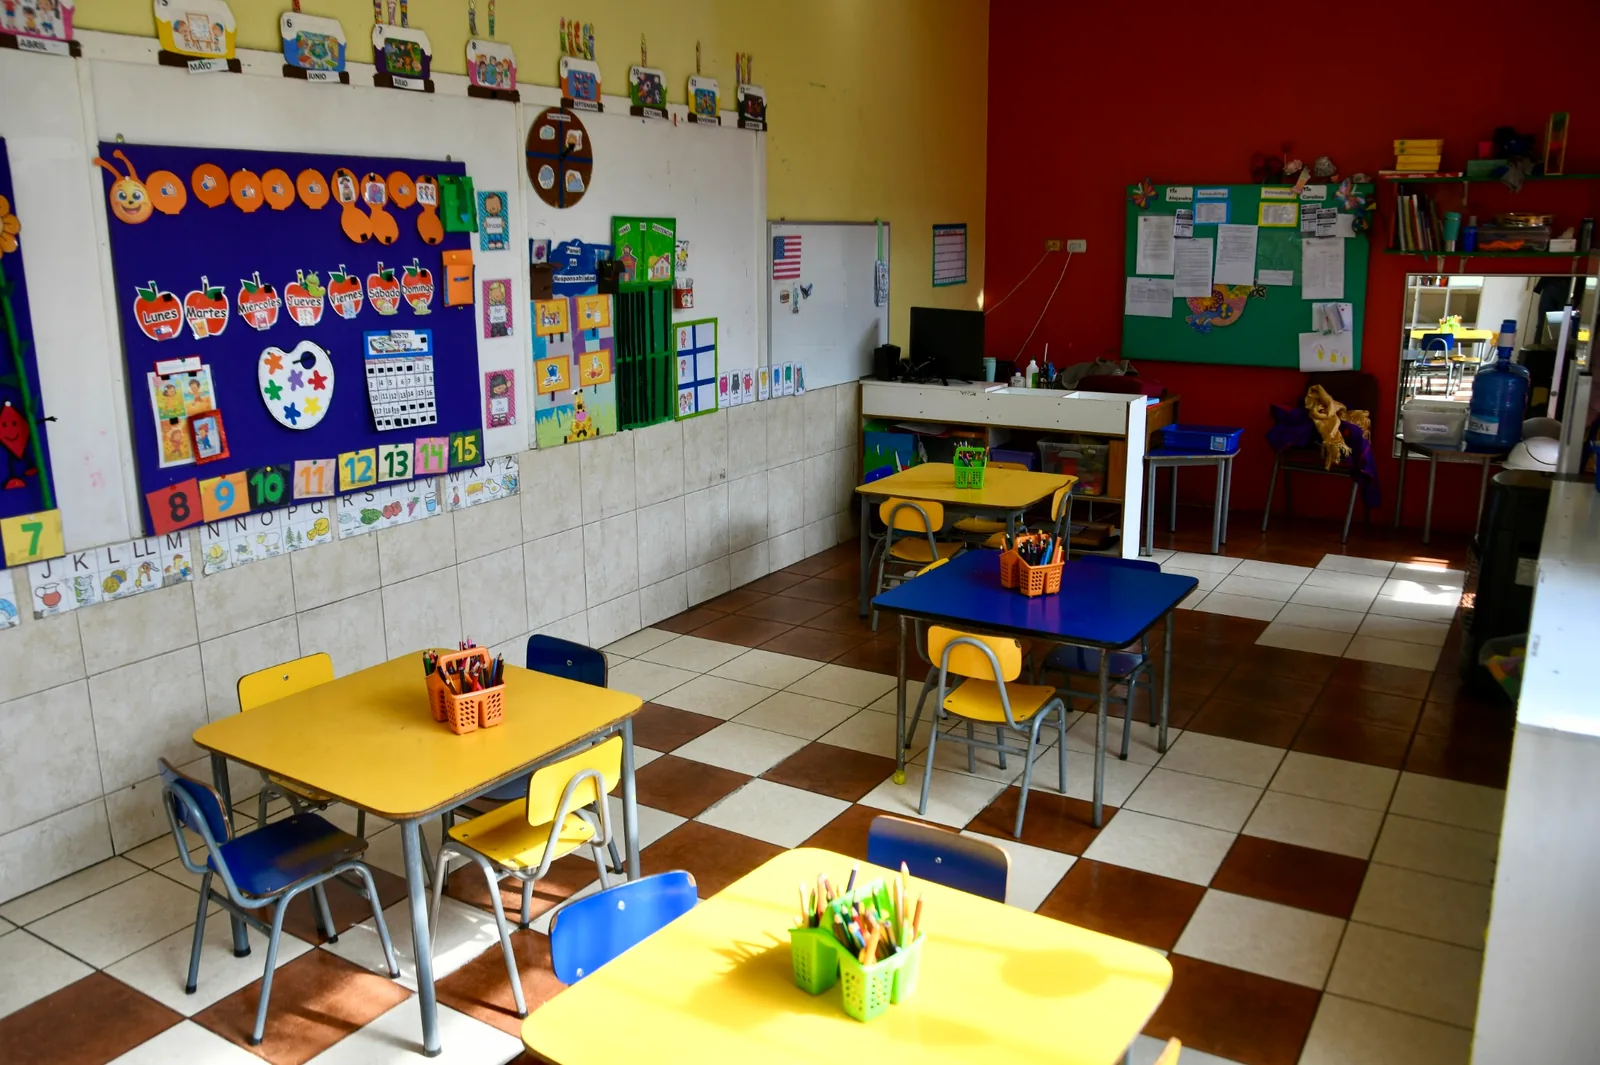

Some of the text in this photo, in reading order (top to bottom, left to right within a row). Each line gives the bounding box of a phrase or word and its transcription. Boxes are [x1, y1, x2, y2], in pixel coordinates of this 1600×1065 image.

[286, 19, 292, 28] 6
[378, 26, 383, 34] 7
[471, 42, 477, 50] 8
[189, 61, 212, 71] MAYO
[563, 60, 569, 68] 9
[308, 72, 327, 80] JUNIO
[633, 68, 640, 76] 10
[394, 79, 408, 87] JULIO
[691, 79, 697, 87] 11
[553, 275, 596, 283] Responsabilidad
[369, 287, 400, 298] Sábado
[401, 284, 434, 295] Domingo
[288, 296, 322, 306] Jueves
[331, 290, 363, 304] Viernes
[143, 309, 178, 324] Lunes
[186, 306, 227, 318] Martes
[1417, 425, 1447, 433] COLACIONES
[449, 456, 513, 482] W X Y Z
[168, 435, 477, 522] 8 9 10 11 12 13 14 15
[342, 494, 353, 507] R
[364, 491, 374, 502] S
[407, 481, 416, 492] U
[425, 478, 433, 488] V
[207, 522, 220, 539] N
[260, 511, 273, 526] O
[287, 505, 298, 520] P
[310, 500, 323, 514] Q
[21, 522, 44, 556] 7
[42, 532, 183, 579] J K L LL M
